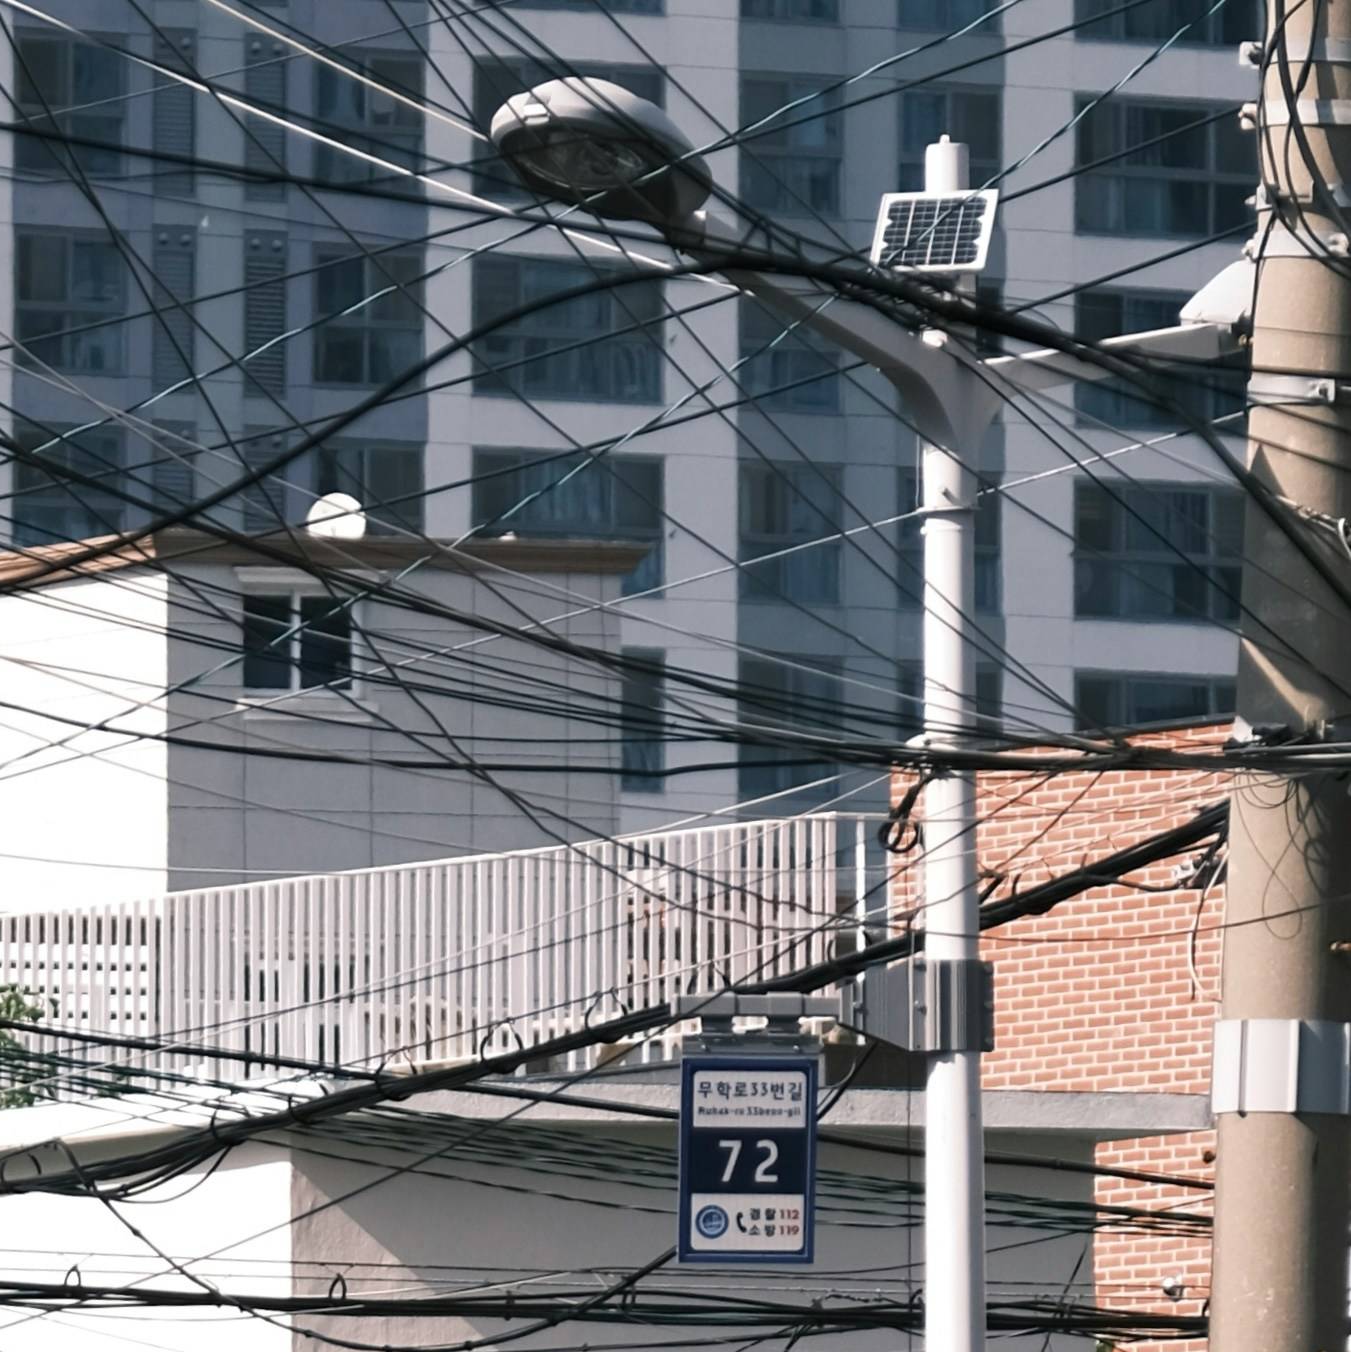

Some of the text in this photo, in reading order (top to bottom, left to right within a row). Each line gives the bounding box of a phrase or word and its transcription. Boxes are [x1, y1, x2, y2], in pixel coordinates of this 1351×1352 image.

[697, 1081, 803, 1101] 무학로33번길
[718, 1139, 779, 1183] 72
[779, 1209, 800, 1220] 112
[779, 1225, 800, 1236] 119
